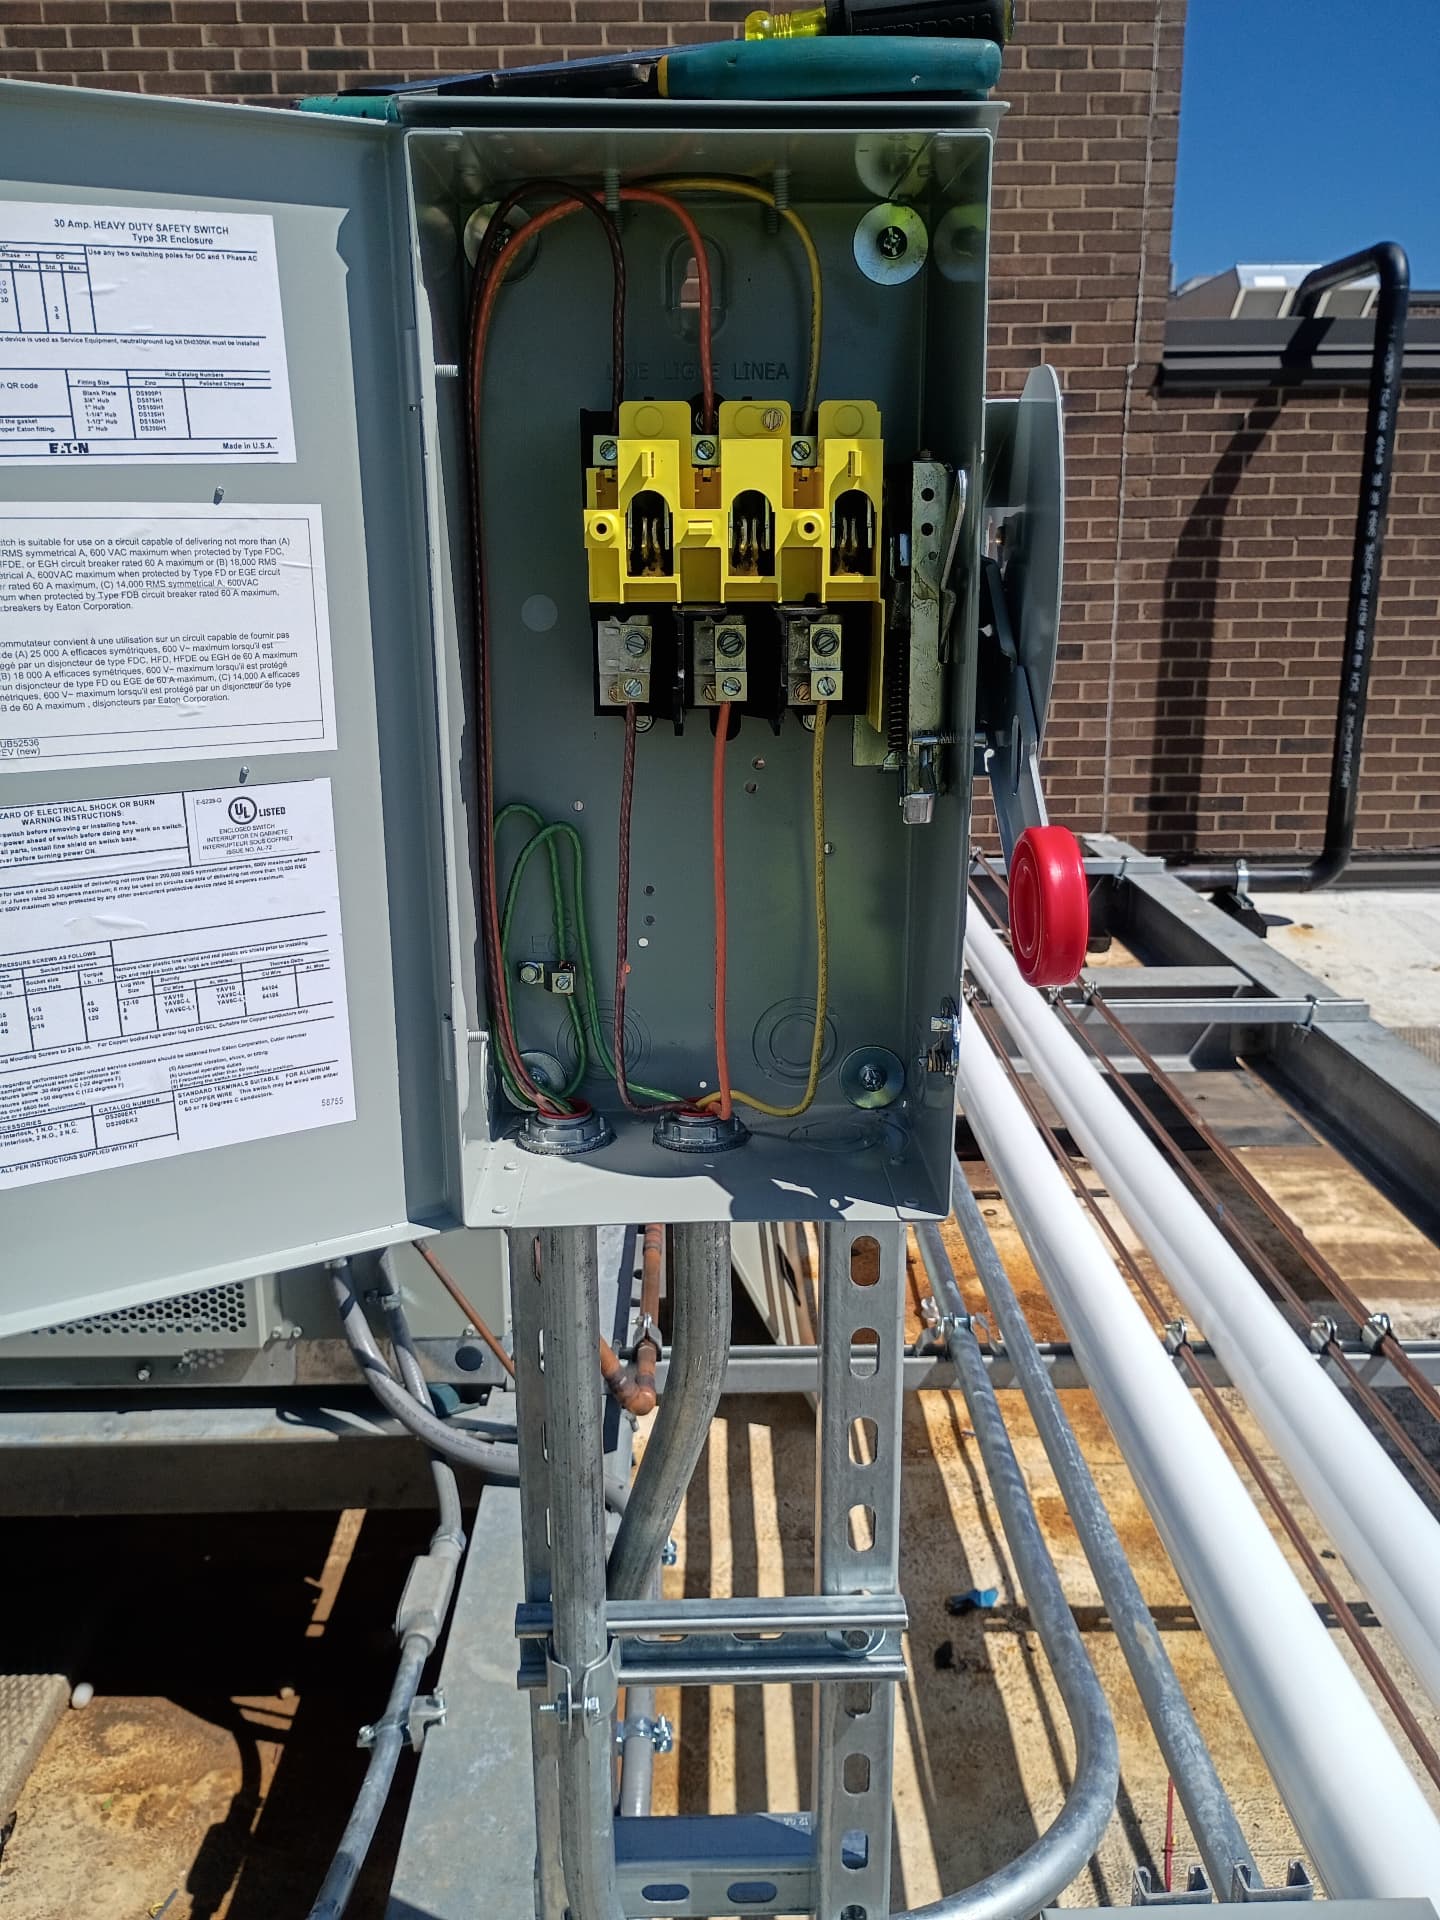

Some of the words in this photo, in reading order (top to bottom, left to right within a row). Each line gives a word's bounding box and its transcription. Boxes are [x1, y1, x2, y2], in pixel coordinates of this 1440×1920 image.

[54, 219, 64, 228] 30
[68, 220, 91, 229] Amp.
[94, 221, 125, 230] HEAVY
[129, 223, 153, 231] DUTY
[156, 224, 191, 233] SAFETY
[194, 226, 229, 235] SWITCH
[132, 233, 153, 243] Type
[156, 235, 167, 243] 3R
[171, 236, 214, 245] Enclosure
[663, 363, 720, 380] LIGE
[734, 363, 789, 380] LINEA
[50, 443, 89, 453] EATON
[28, 538, 61, 546] suitable
[142, 538, 172, 546] capable
[185, 538, 222, 546] delivering
[279, 537, 290, 546] (A)
[26, 548, 76, 558] symmetrical
[79, 549, 87, 557] A,
[194, 548, 230, 556] protected
[232, 548, 241, 556] by
[244, 548, 262, 556] Type
[265, 548, 284, 556] FDC,
[38, 560, 58, 568] EGH
[216, 559, 228, 567] (B)
[230, 558, 256, 566] 18,000
[45, 593, 83, 601] protected
[86, 592, 95, 600] by
[98, 592, 118, 600] Type
[241, 589, 279, 597] maximum,
[4, 604, 41, 612] breakers
[44, 603, 53, 612] by
[54, 638, 88, 646] convient
[116, 636, 153, 644] utilisation
[208, 633, 237, 641] capable
[17, 748, 40, 756] (new)
[37, 806, 87, 816] ELECTRICAL
[90, 803, 117, 811] SHOCK
[235, 803, 250, 818] UL
[259, 806, 286, 816] LISTED
[22, 816, 61, 825] WARNING
[50, 825, 80, 833] removing
[91, 821, 120, 829] installing
[219, 826, 251, 834] ENCLOSED
[178, 1086, 212, 1098] STANDARD
[214, 1080, 248, 1093] TERMINALS
[250, 1075, 279, 1085] SUITABLE
[300, 1066, 330, 1076] ALUMINUM
[99, 1104, 131, 1113] CATALOG
[133, 1098, 160, 1107] NUMBER
[179, 1098, 188, 1106] OR
[189, 1095, 215, 1104] COPPER
[15, 1164, 29, 1172] PER
[30, 1155, 78, 1168] INSTRUCTIONS
[79, 1149, 110, 1159] SUPPLIED
[111, 1145, 127, 1153] WITH
